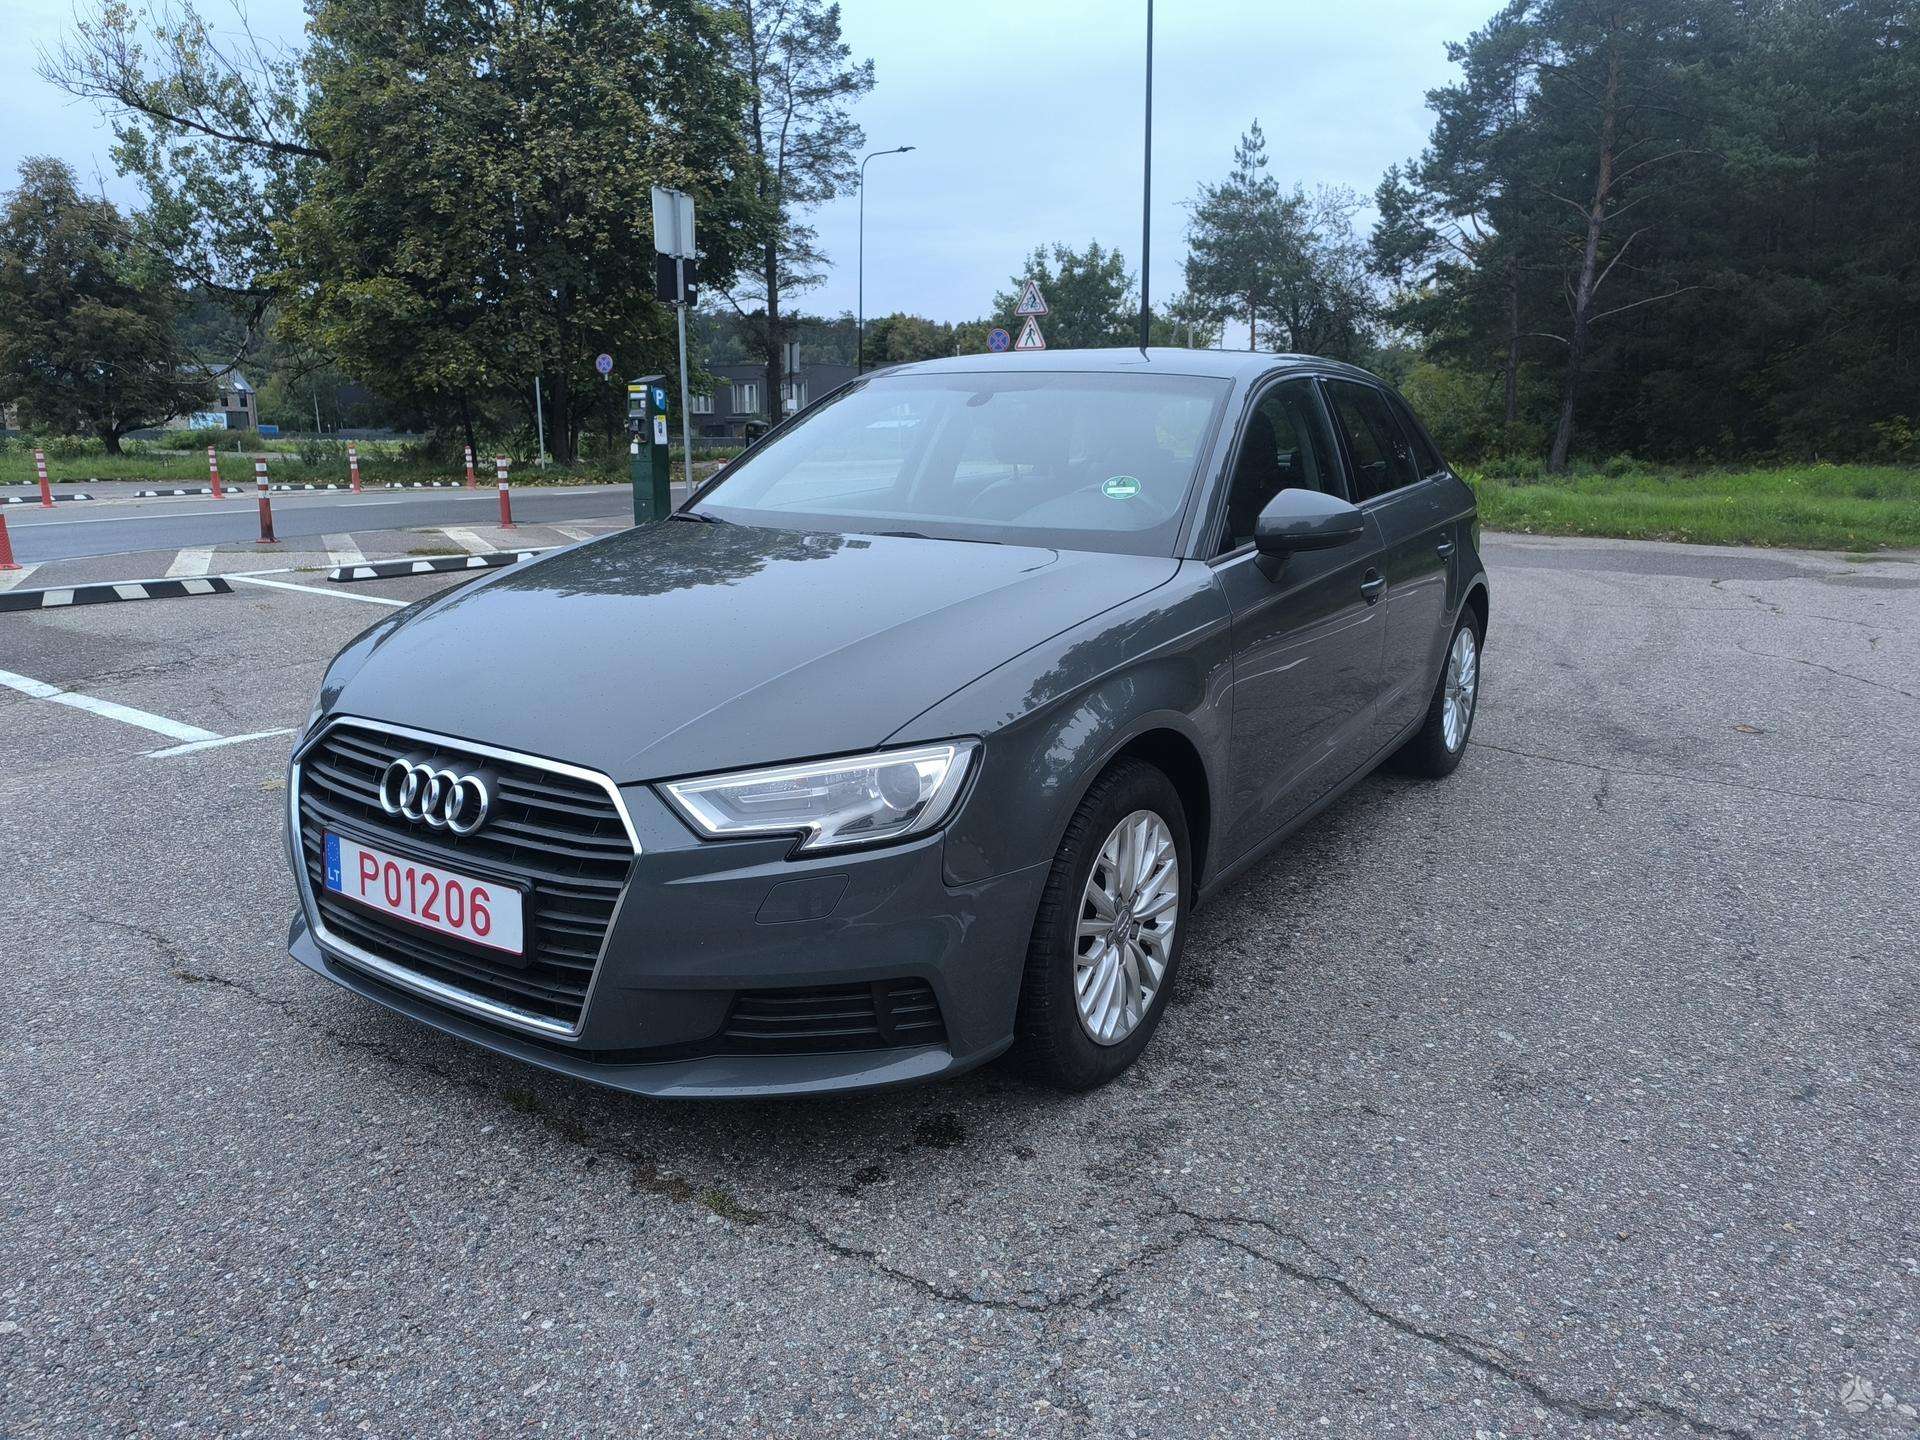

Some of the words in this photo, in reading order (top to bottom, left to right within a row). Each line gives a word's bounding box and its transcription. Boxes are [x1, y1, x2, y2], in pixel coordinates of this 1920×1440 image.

[656, 389, 664, 406] P
[327, 867, 340, 882] LT
[359, 851, 491, 936] P01206
